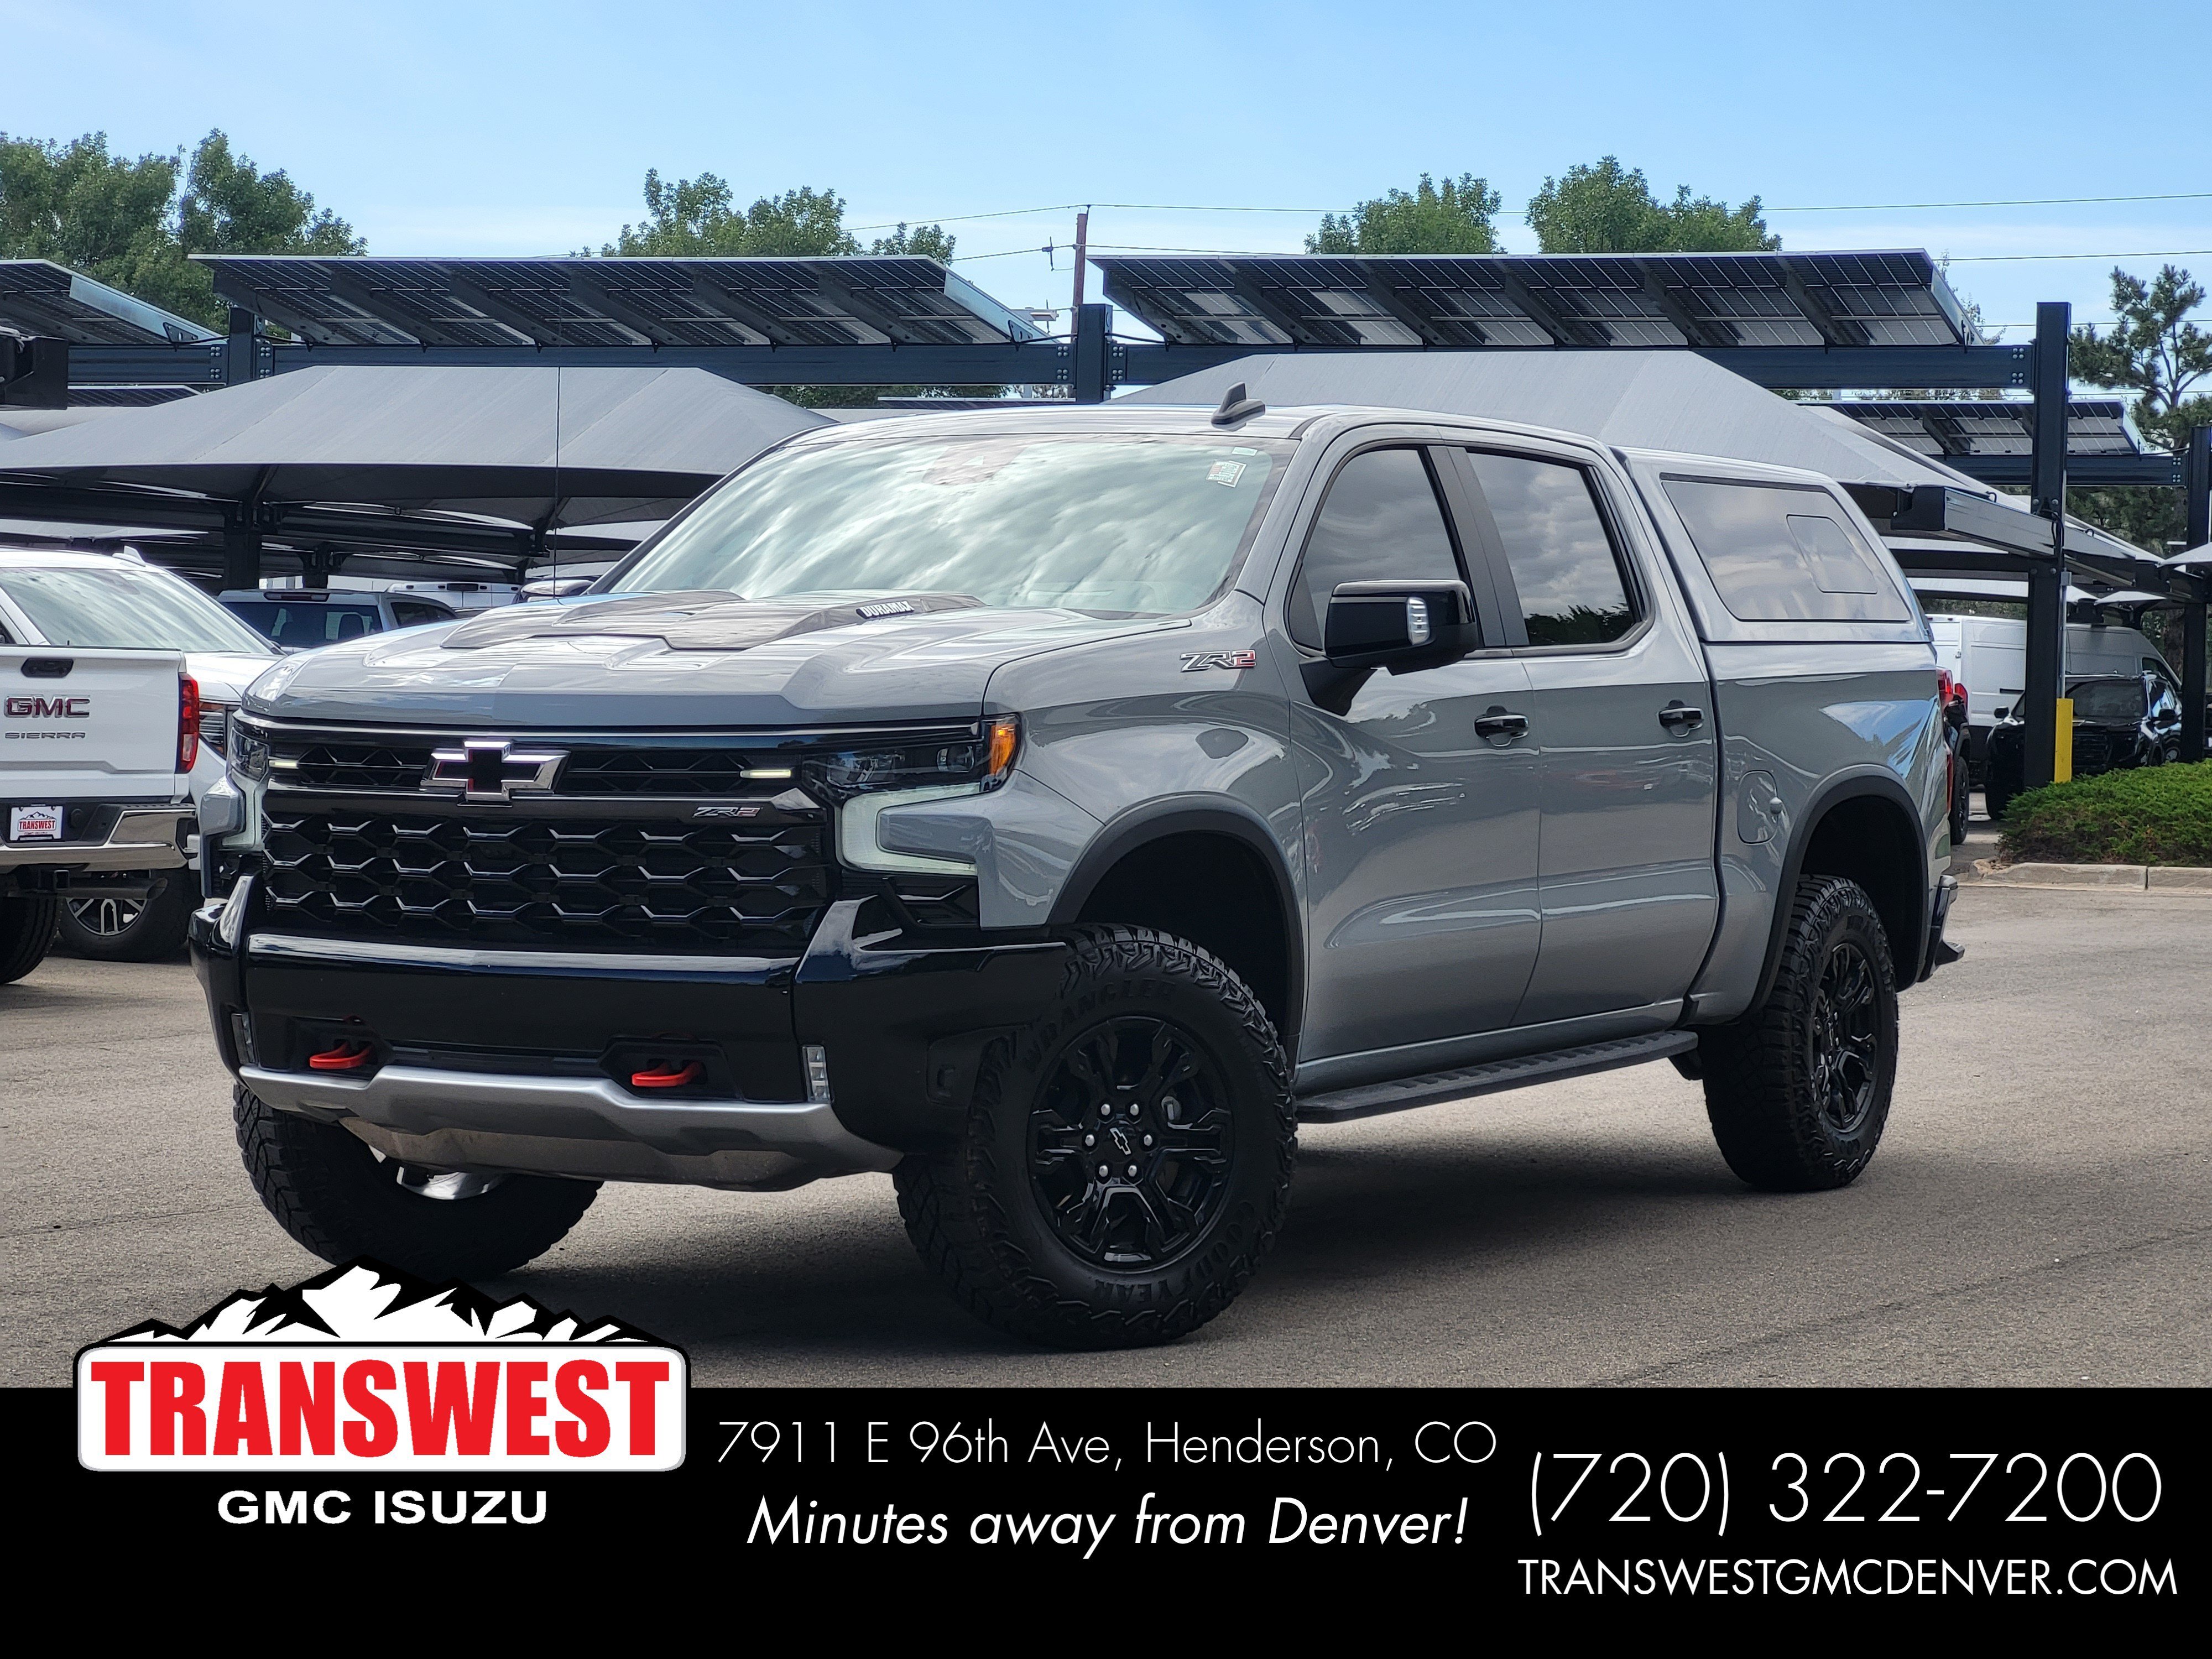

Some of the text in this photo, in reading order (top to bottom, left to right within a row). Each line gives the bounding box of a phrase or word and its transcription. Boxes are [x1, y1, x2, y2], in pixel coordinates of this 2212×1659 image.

[858, 601, 914, 617] DURAMAX
[1180, 650, 1256, 672] ZR2
[4, 694, 90, 718] GMC
[692, 807, 760, 817] ZR2
[19, 820, 55, 830] TRANSWEST
